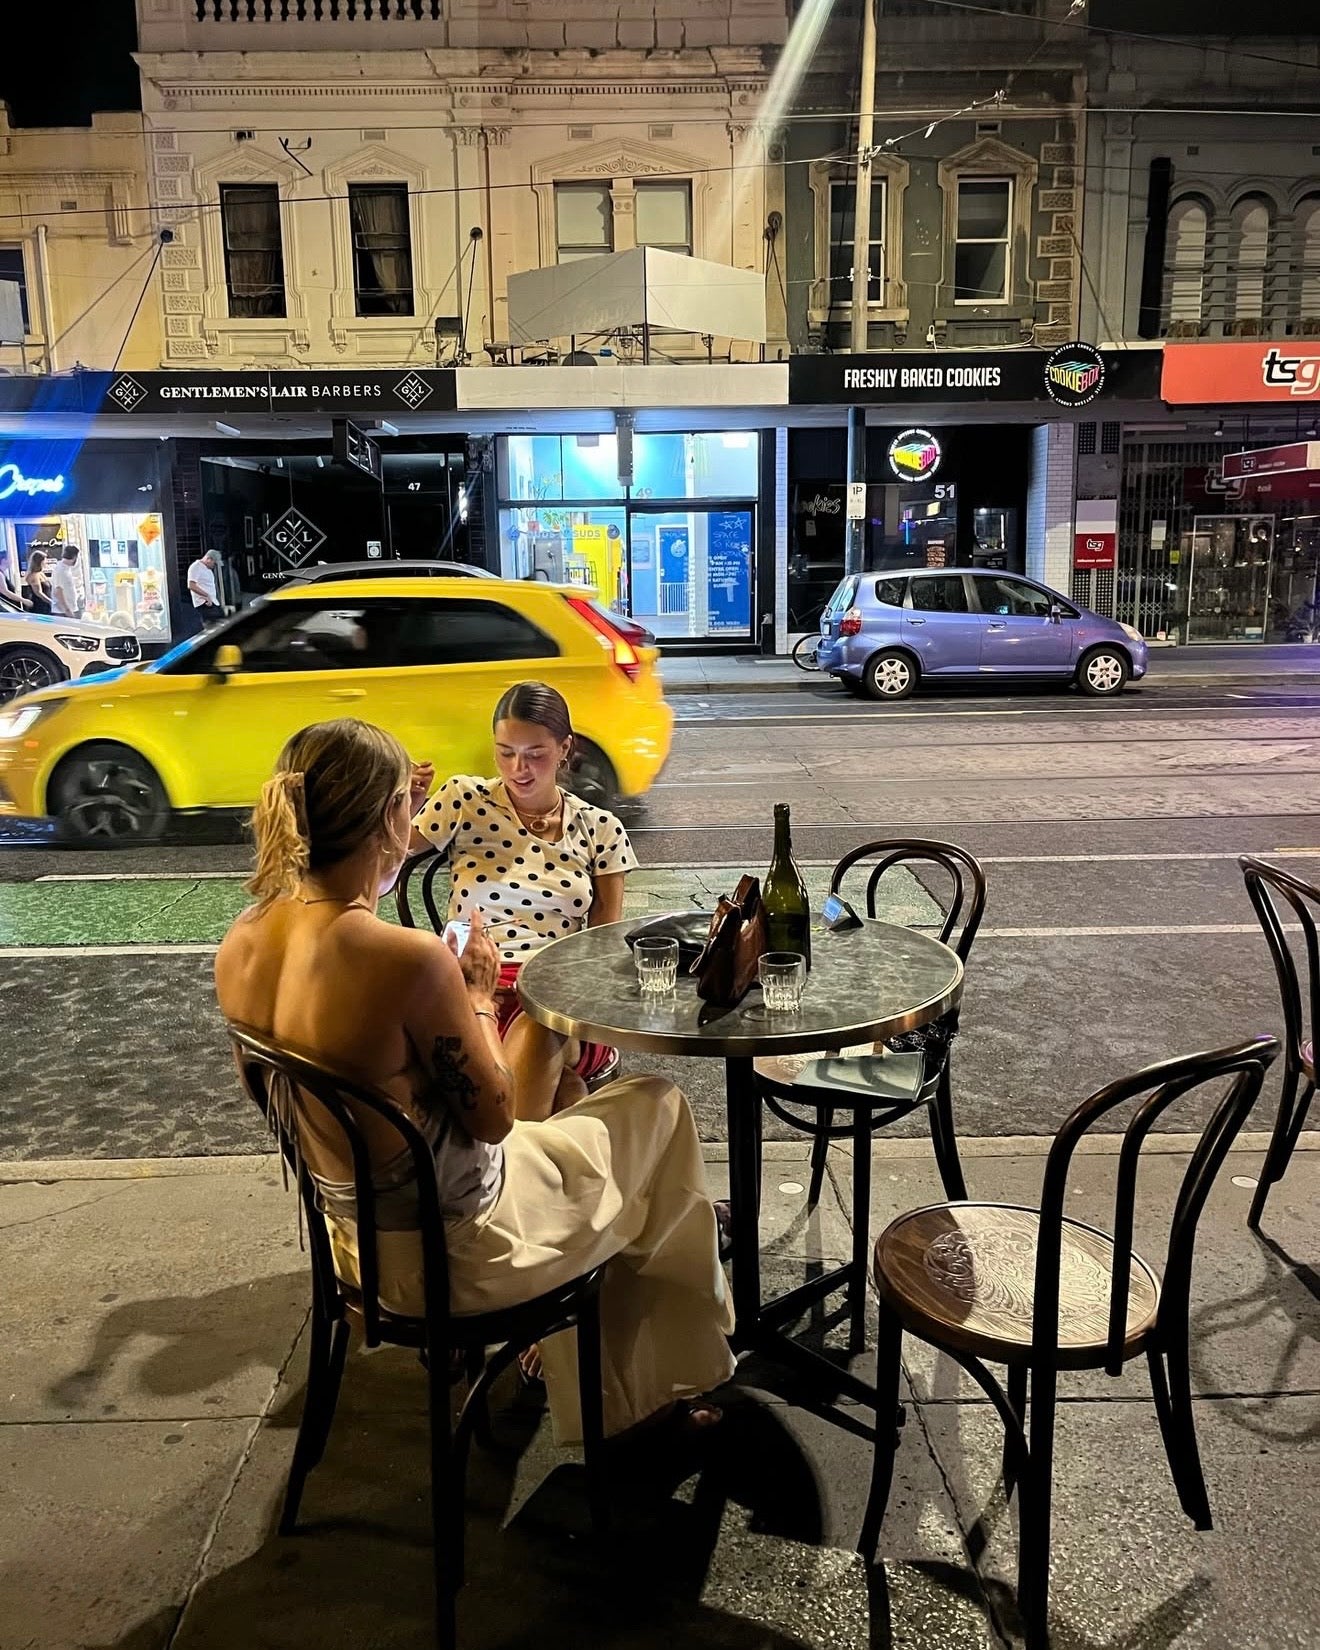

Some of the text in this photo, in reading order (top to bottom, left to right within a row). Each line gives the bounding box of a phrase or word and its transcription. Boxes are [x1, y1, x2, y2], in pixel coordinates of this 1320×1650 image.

[844, 367, 1001, 388] FRESHLY BAKED COOKIES
[159, 384, 382, 398] GENTLEMEN'S LAIR BARBERS
[407, 482, 421, 491] 47
[934, 484, 955, 499] 51
[573, 529, 601, 538] SUDS
